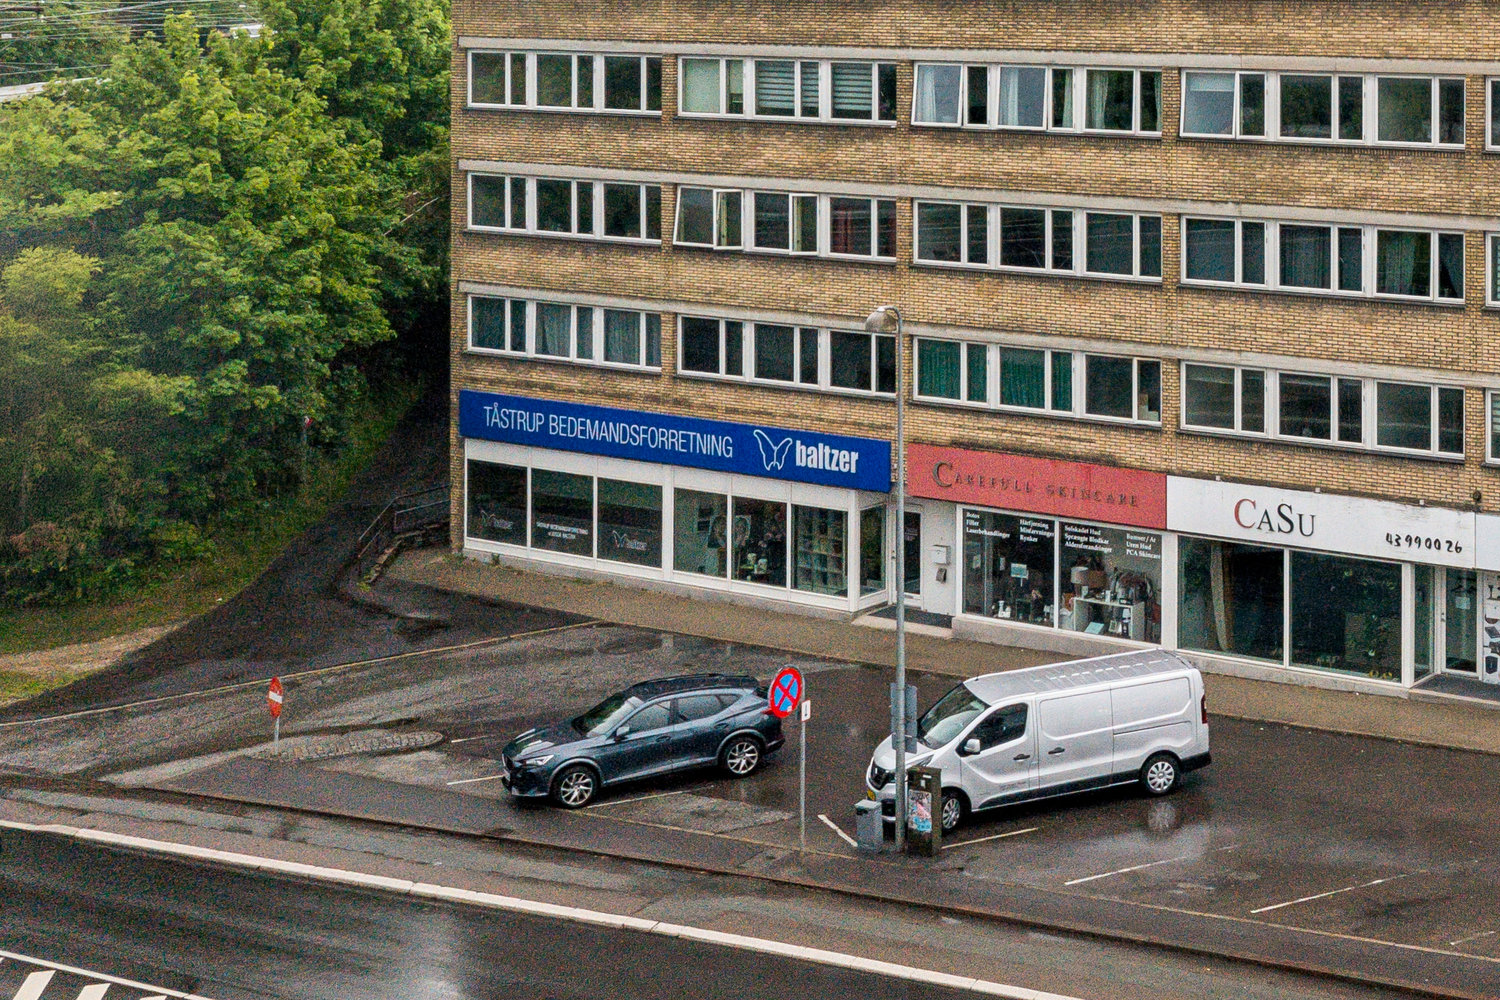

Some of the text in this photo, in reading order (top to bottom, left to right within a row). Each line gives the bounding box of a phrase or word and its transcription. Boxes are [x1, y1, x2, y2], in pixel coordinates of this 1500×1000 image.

[483, 402, 733, 459] TÅSTRUP BEDEMANDSFORRETNING
[795, 442, 860, 474] baltzer
